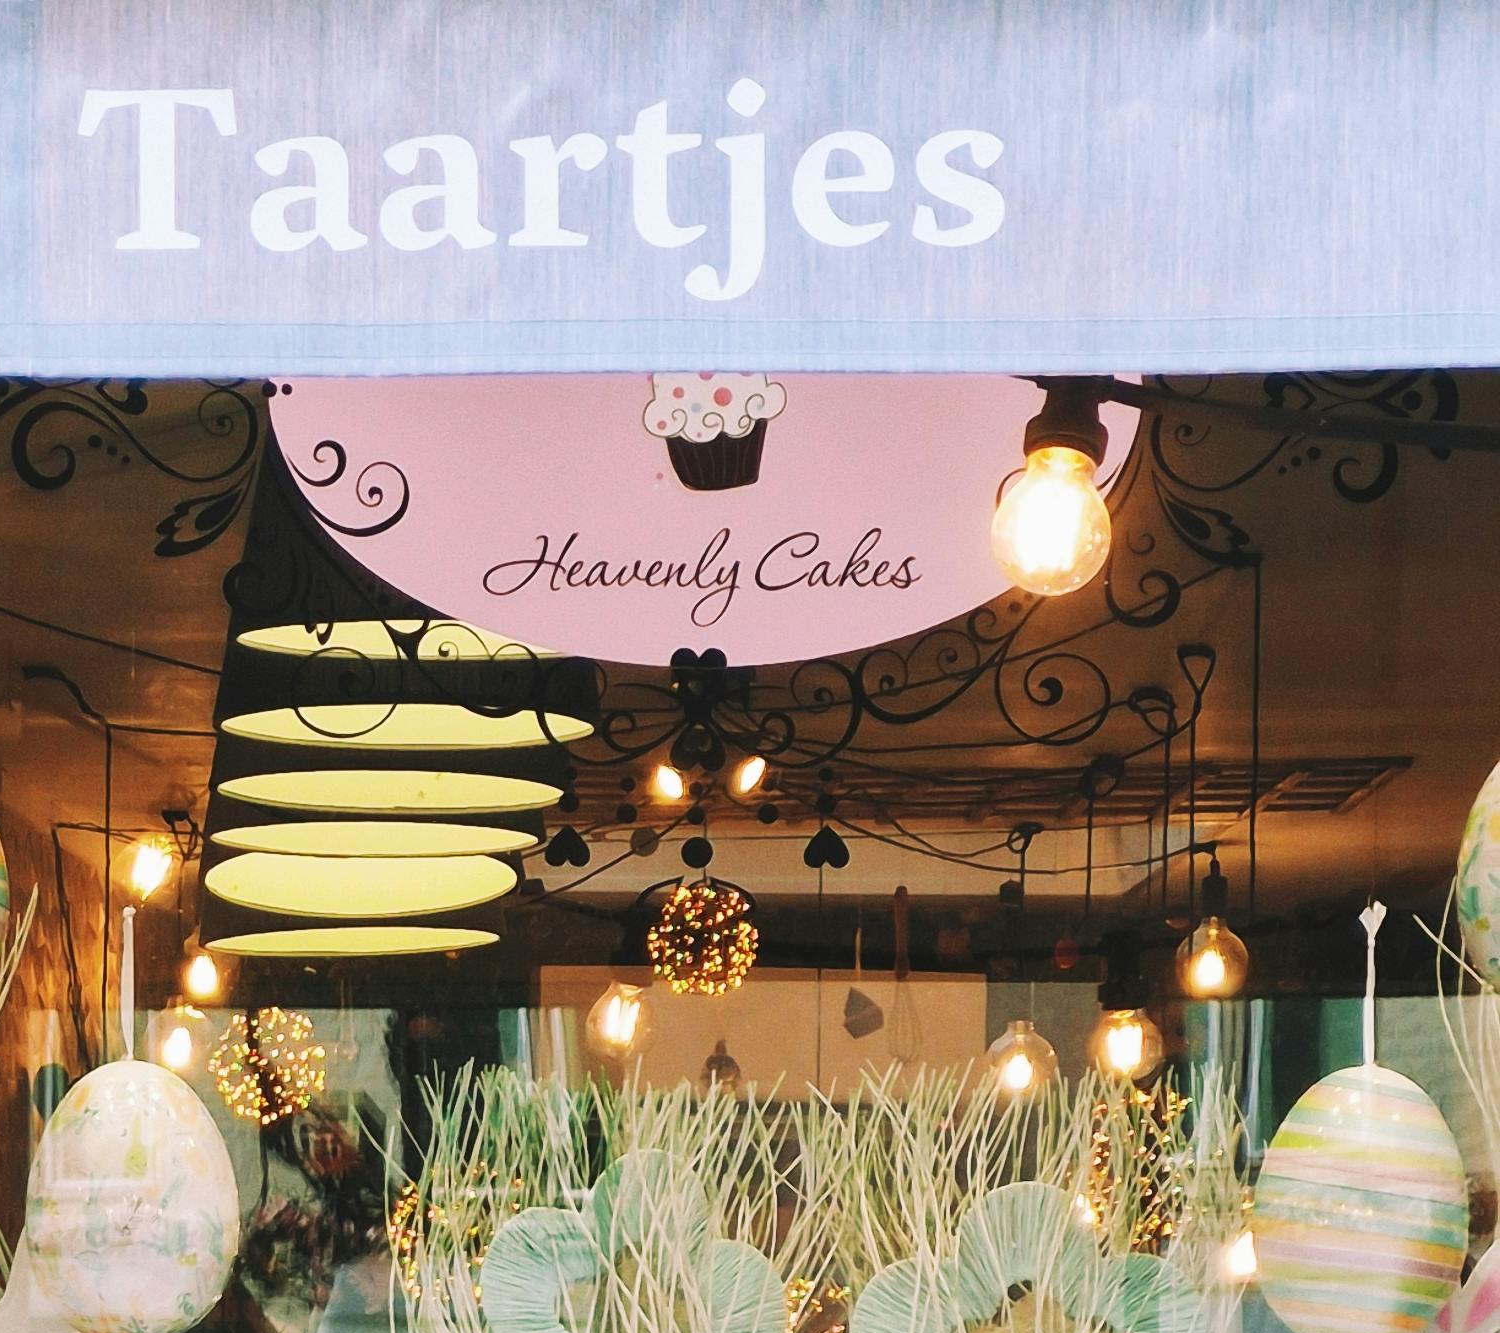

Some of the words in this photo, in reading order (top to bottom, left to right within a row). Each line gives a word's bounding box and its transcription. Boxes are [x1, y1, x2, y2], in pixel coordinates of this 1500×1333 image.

[77, 77, 1005, 301] Taartjes
[482, 527, 740, 628] Heavenly
[754, 527, 921, 592] Cakes
